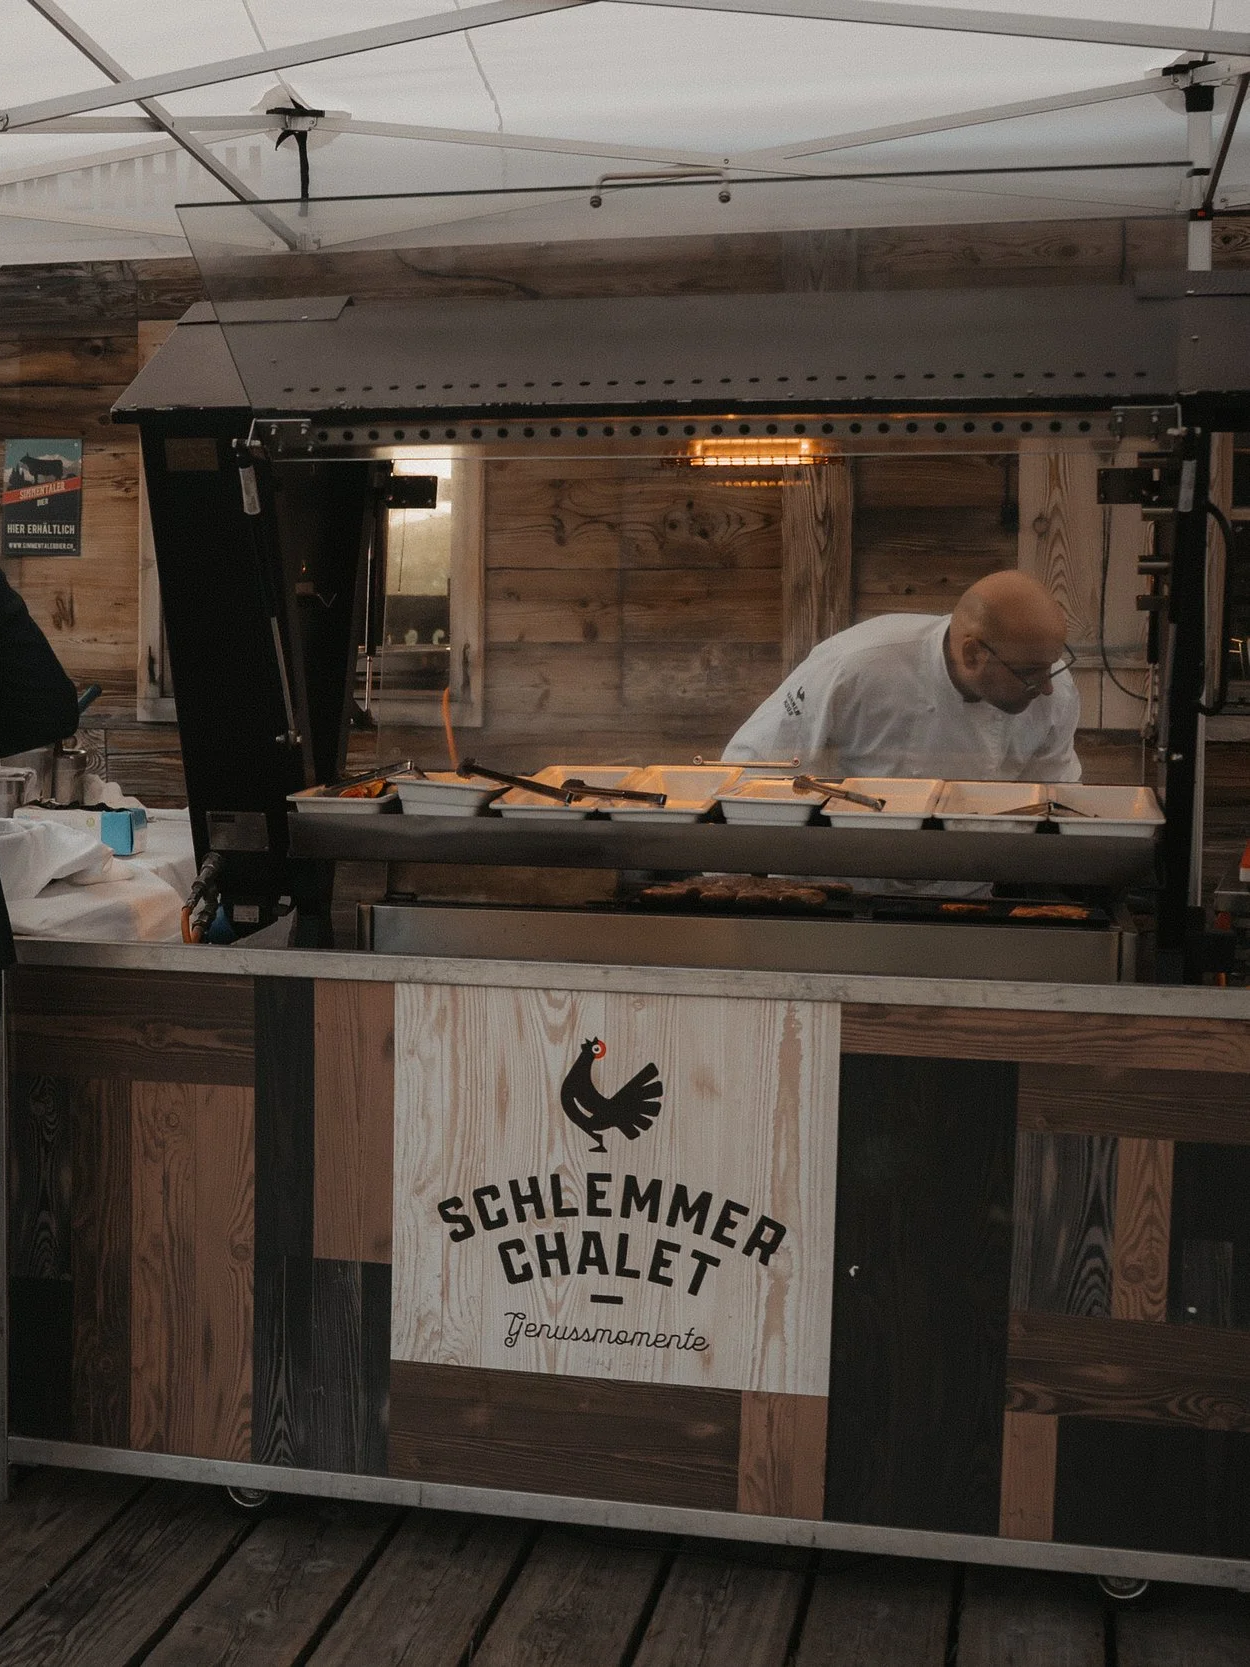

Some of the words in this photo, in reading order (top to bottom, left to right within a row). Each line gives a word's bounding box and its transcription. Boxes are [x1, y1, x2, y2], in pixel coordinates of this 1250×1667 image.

[19, 481, 66, 500] SIMMENTALER
[7, 523, 25, 534] HIER
[27, 521, 75, 535] ERHÄLTLICH
[436, 1172, 787, 1267] SCHLEMMER
[497, 1230, 722, 1297] CHALET
[503, 1311, 710, 1352] Genussmomente
